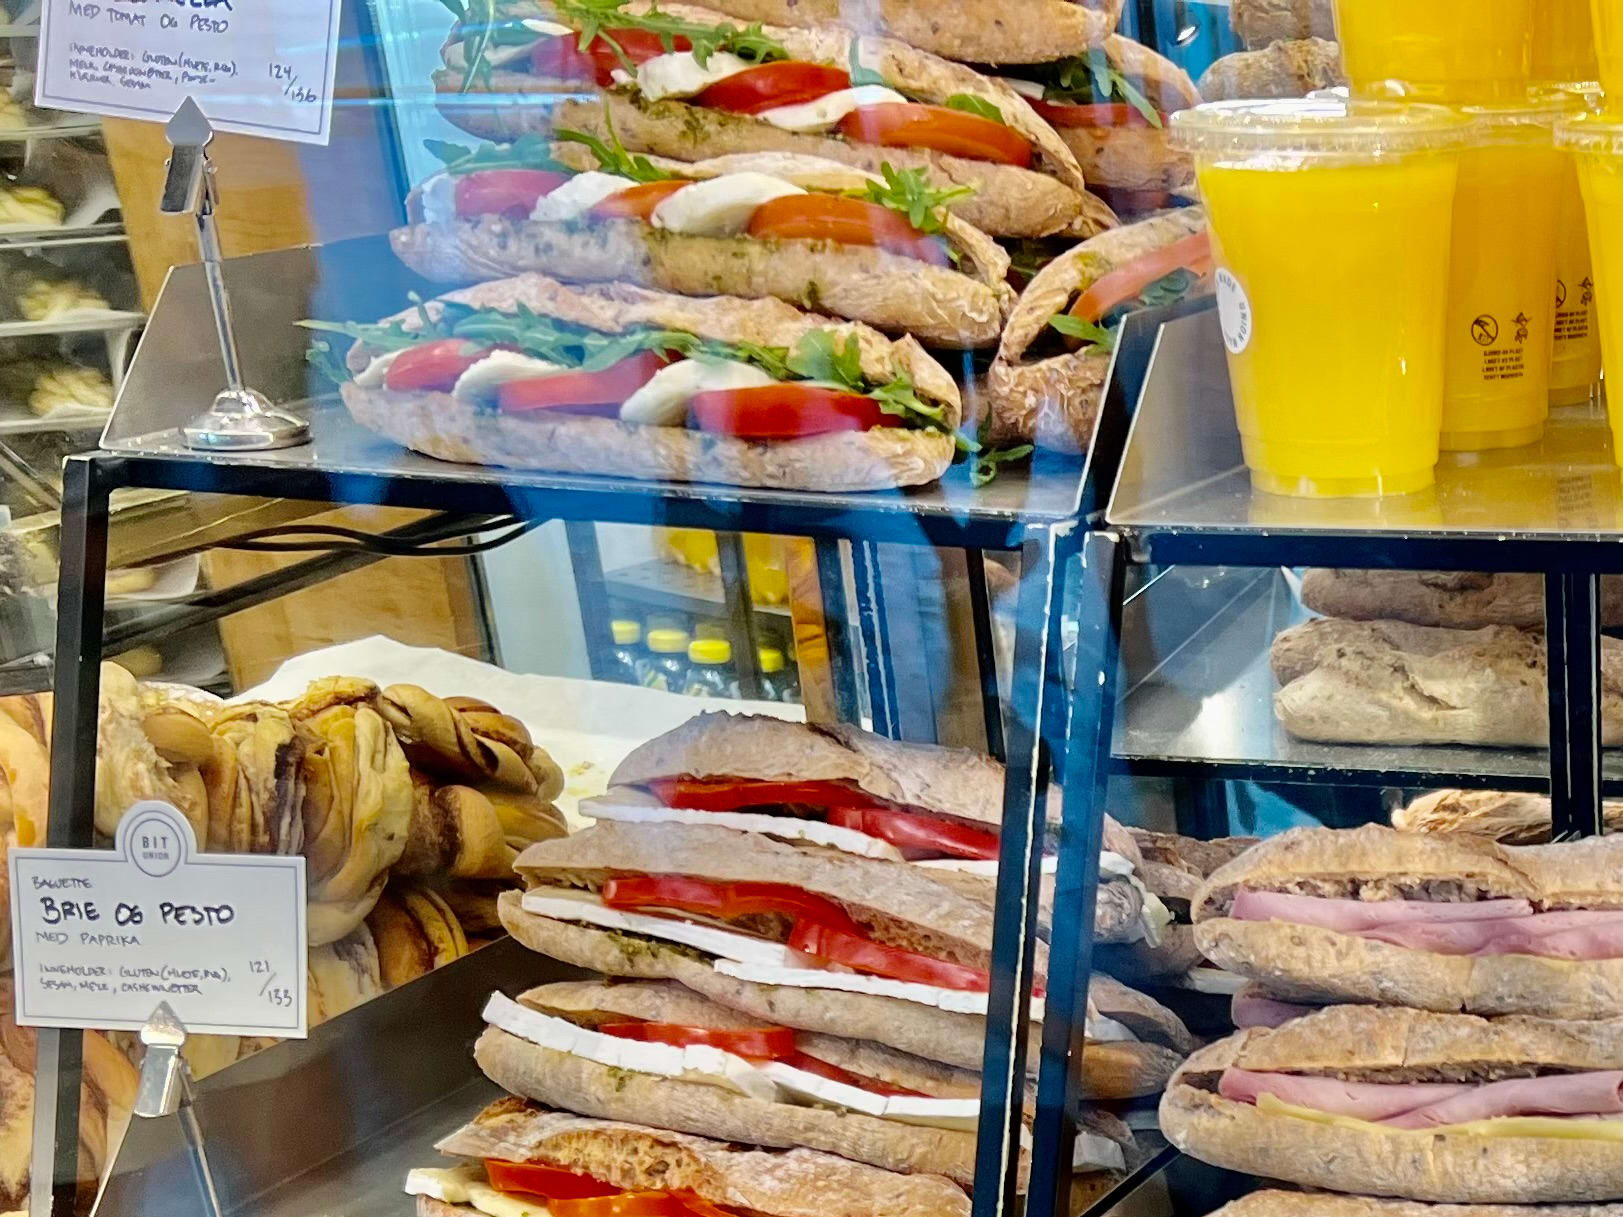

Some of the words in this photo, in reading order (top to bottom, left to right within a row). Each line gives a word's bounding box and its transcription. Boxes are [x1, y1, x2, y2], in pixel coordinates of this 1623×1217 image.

[69, 1, 100, 19] MED
[107, 8, 146, 26] TOMAT
[160, 13, 178, 29] OG
[190, 14, 228, 33] PESTO
[142, 835, 169, 850] BIT
[40, 896, 100, 925] BRIE
[115, 902, 143, 926] OG
[159, 901, 234, 926] PESTO
[36, 931, 69, 945] MED
[80, 931, 141, 946] PAPRIKA
